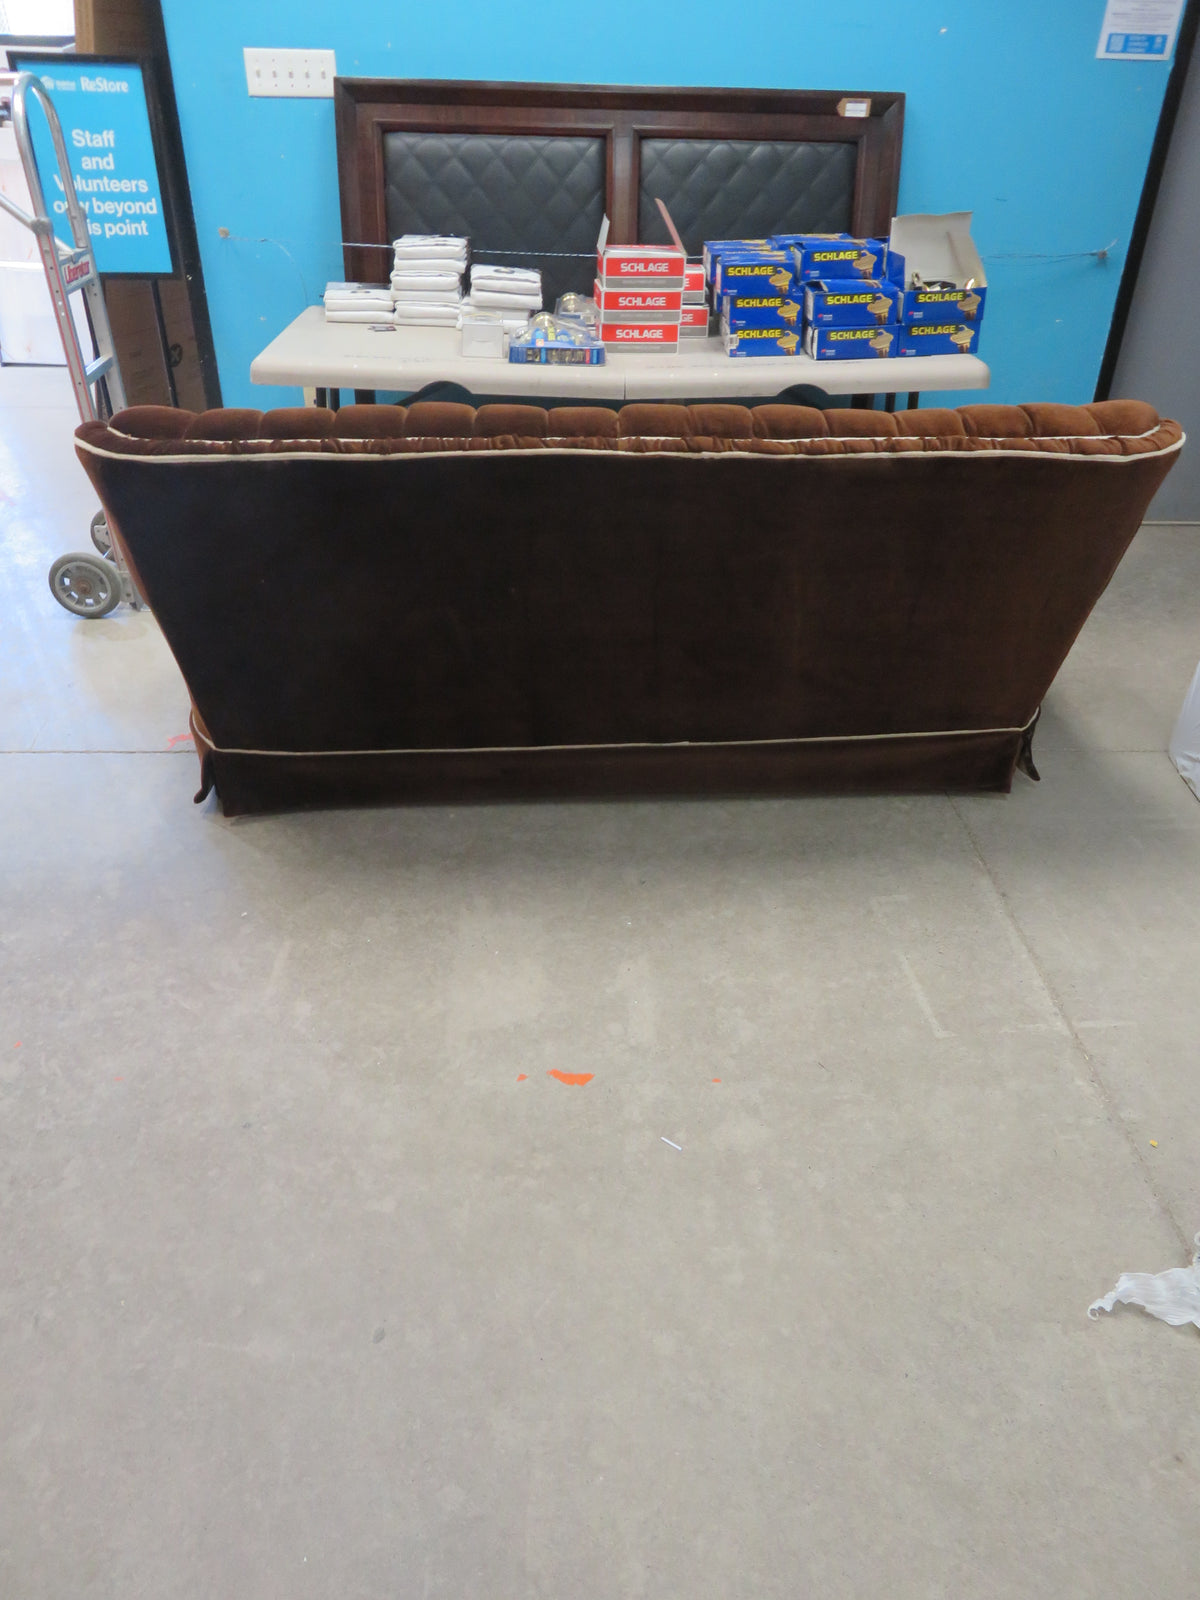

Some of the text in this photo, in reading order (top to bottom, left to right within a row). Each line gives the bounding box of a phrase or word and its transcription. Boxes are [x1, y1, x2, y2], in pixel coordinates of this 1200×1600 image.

[80, 76, 129, 93] ReStore
[71, 129, 115, 148] Staff
[81, 153, 115, 170] and
[91, 197, 157, 217] beyond
[104, 219, 149, 238] point
[814, 250, 859, 262] SCHLAGE
[620, 262, 669, 273] SCHLAGE
[727, 266, 774, 276] SCHLAGE
[618, 296, 667, 307] SCHLAGE
[736, 298, 782, 308] SCHLAGE
[826, 294, 874, 305] SCHLAGE
[917, 292, 964, 303] SCHLAGE
[615, 329, 664, 339] SCHLAGE
[737, 329, 782, 339] SCHLAGE
[829, 329, 876, 341] SCHLAGE
[911, 325, 957, 336] SCHLAGE
